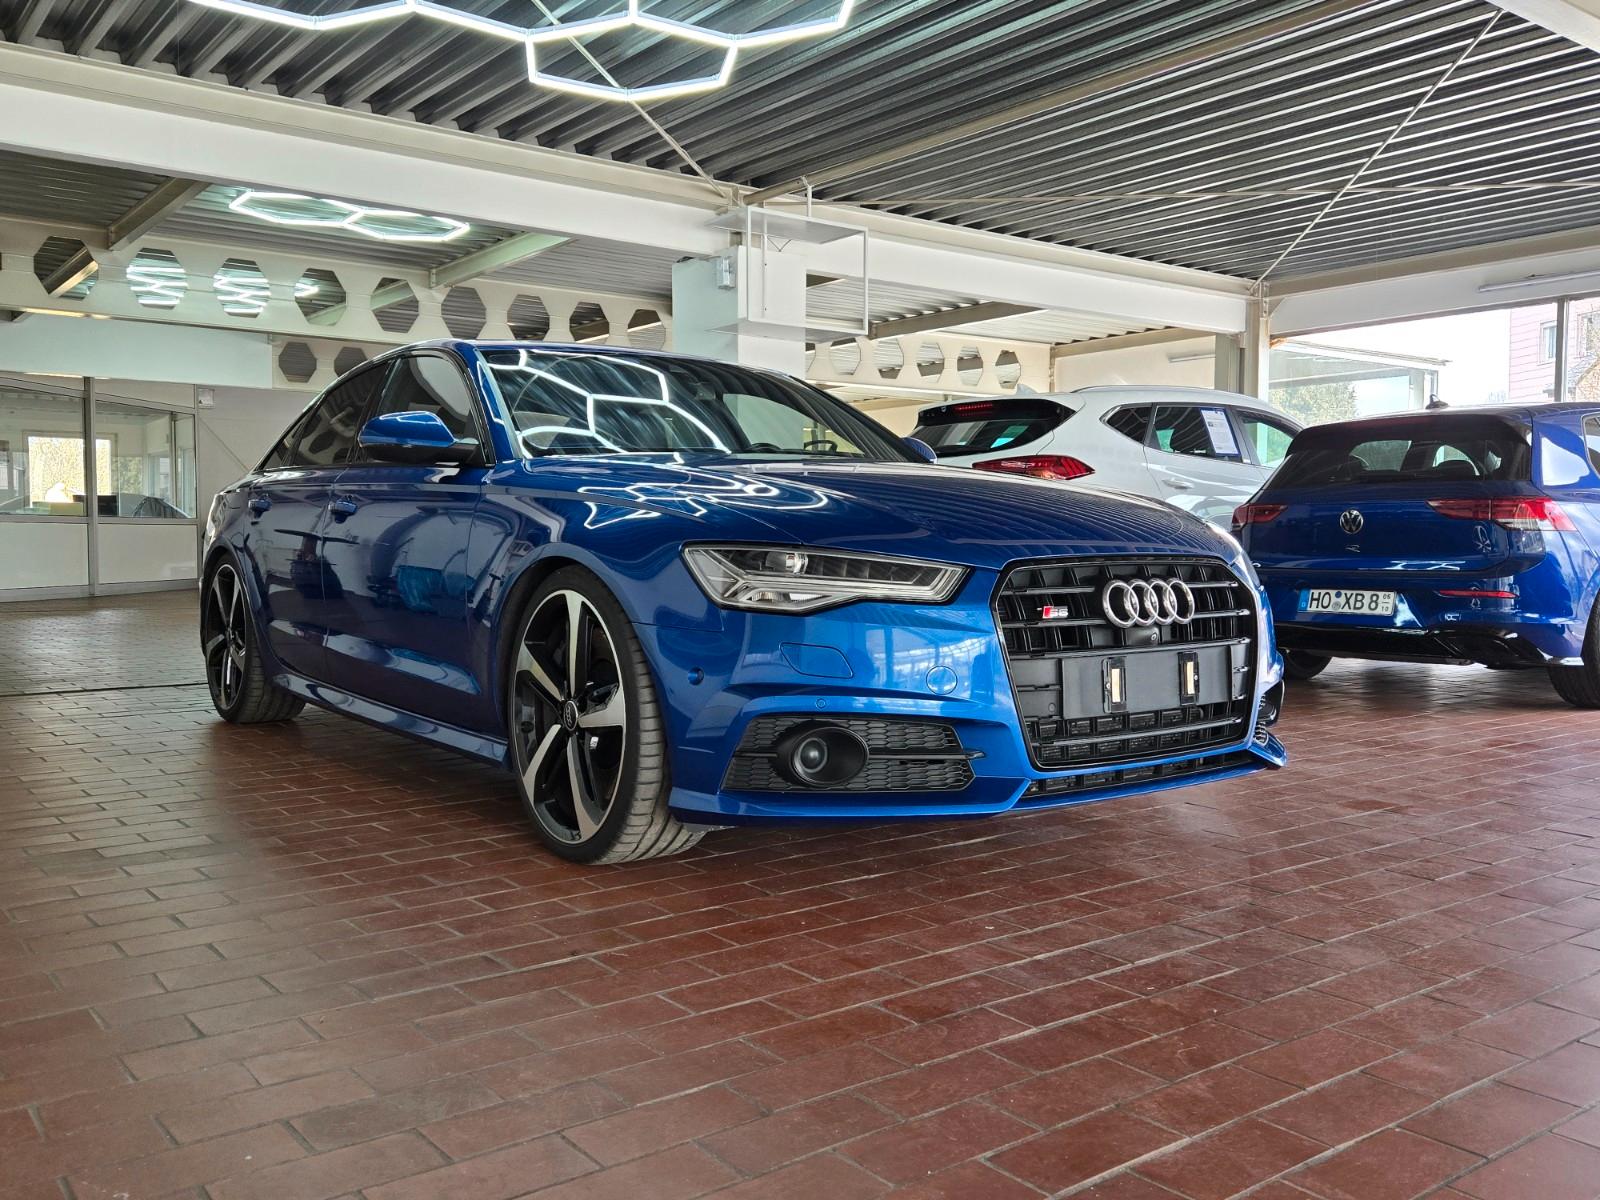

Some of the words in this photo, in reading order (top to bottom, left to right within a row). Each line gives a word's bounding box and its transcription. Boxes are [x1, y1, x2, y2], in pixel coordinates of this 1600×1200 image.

[1309, 591, 1332, 609] HO
[1341, 592, 1365, 611] XB
[1368, 593, 1380, 611] 8
